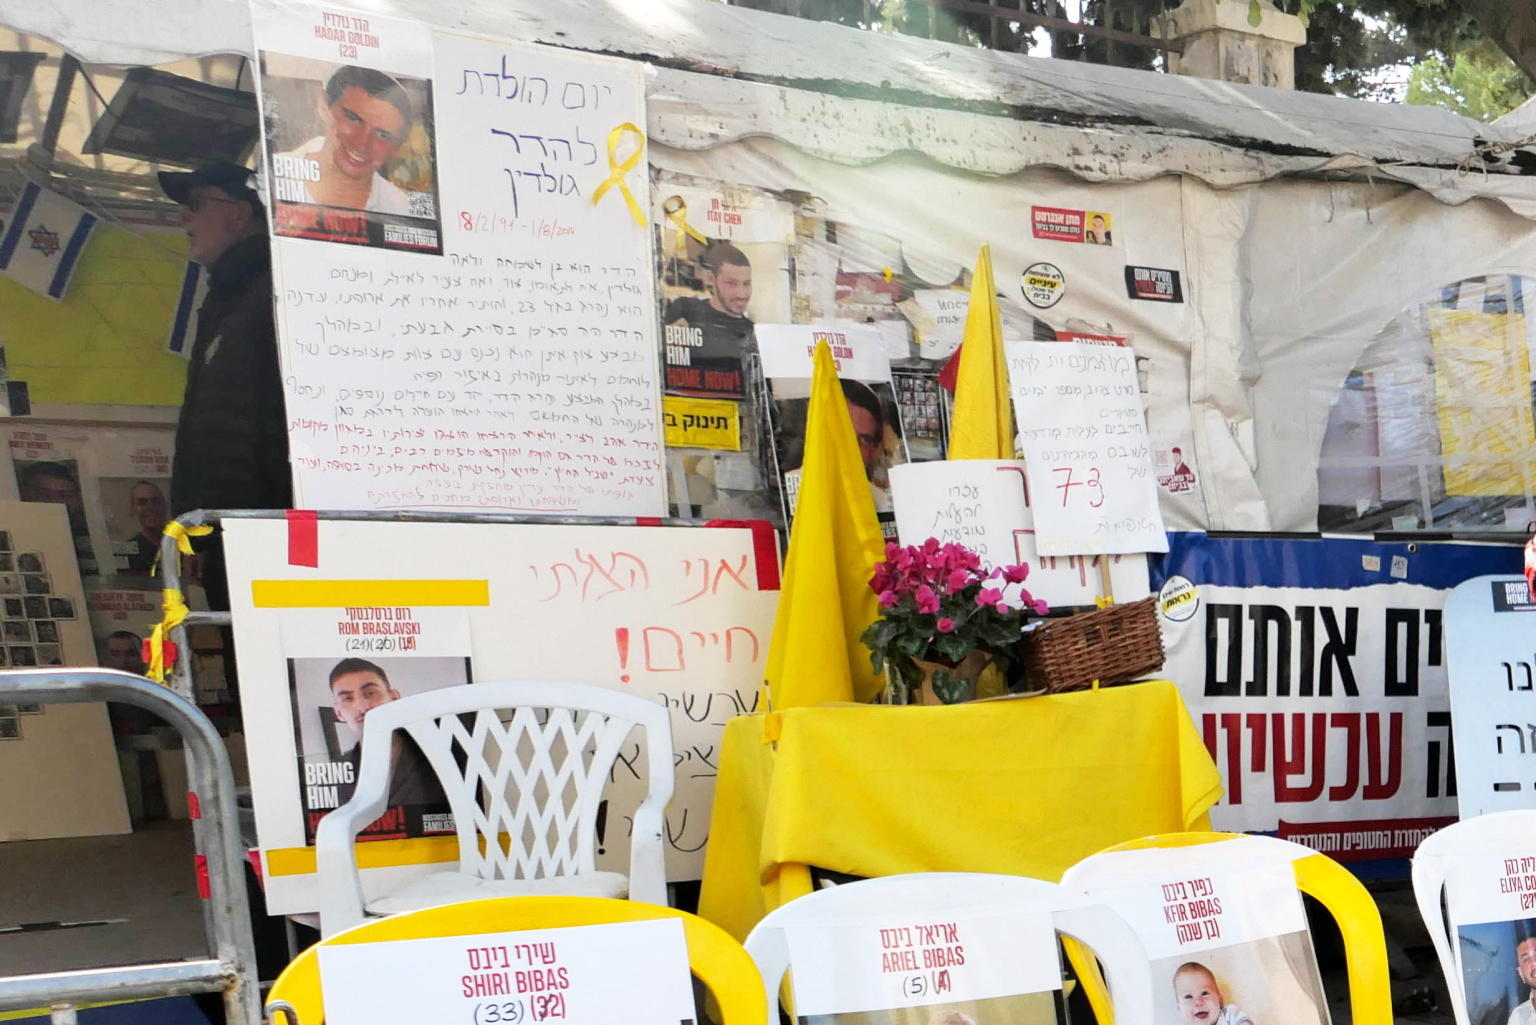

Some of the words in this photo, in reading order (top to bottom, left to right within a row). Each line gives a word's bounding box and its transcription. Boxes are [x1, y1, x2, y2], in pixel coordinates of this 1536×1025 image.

[315, 26, 346, 43] HADAR
[348, 32, 379, 48] GOLDIN
[339, 45, 358, 59] (23)
[456, 55, 548, 105] הולדת
[562, 82, 611, 110] יום
[491, 126, 597, 165] להדר
[273, 154, 320, 181] BRING
[275, 178, 307, 202] HIM
[504, 162, 580, 218] גולדין
[707, 210, 721, 222] ITAY
[724, 213, 741, 225] CHEN
[665, 325, 703, 347] BRING
[666, 345, 691, 366] HIM
[683, 415, 728, 432] תינוק
[1052, 467, 1104, 508] 73
[529, 548, 649, 603] הצלתי
[672, 554, 750, 606] אני
[1504, 583, 1528, 594] BRING
[1506, 594, 1528, 605] HOME
[345, 606, 392, 621] ברסלבסקי
[395, 607, 411, 620] רום
[338, 622, 359, 635] ROM
[362, 622, 420, 635] BRASLAVSKI
[1202, 603, 1360, 697] אותם
[304, 762, 354, 785] BRING
[307, 785, 339, 809] HIM
[1344, 830, 1391, 850] החטופים
[1504, 859, 1519, 876] כהן
[1162, 882, 1187, 902] ביבס
[1187, 877, 1213, 898] כפיר
[1500, 876, 1523, 893] ELIYA
[1163, 904, 1188, 924] KFIR
[1188, 897, 1222, 919] BIBAS
[880, 927, 913, 949] ביבס
[915, 923, 959, 946] אריאל
[467, 946, 510, 970] ביבס
[515, 942, 556, 966] שירי
[882, 950, 921, 973] ARIEL
[923, 946, 965, 969] BIBAS
[462, 972, 510, 998] SHIRI
[515, 967, 569, 993] BIBAS
[903, 975, 928, 998] (5)
